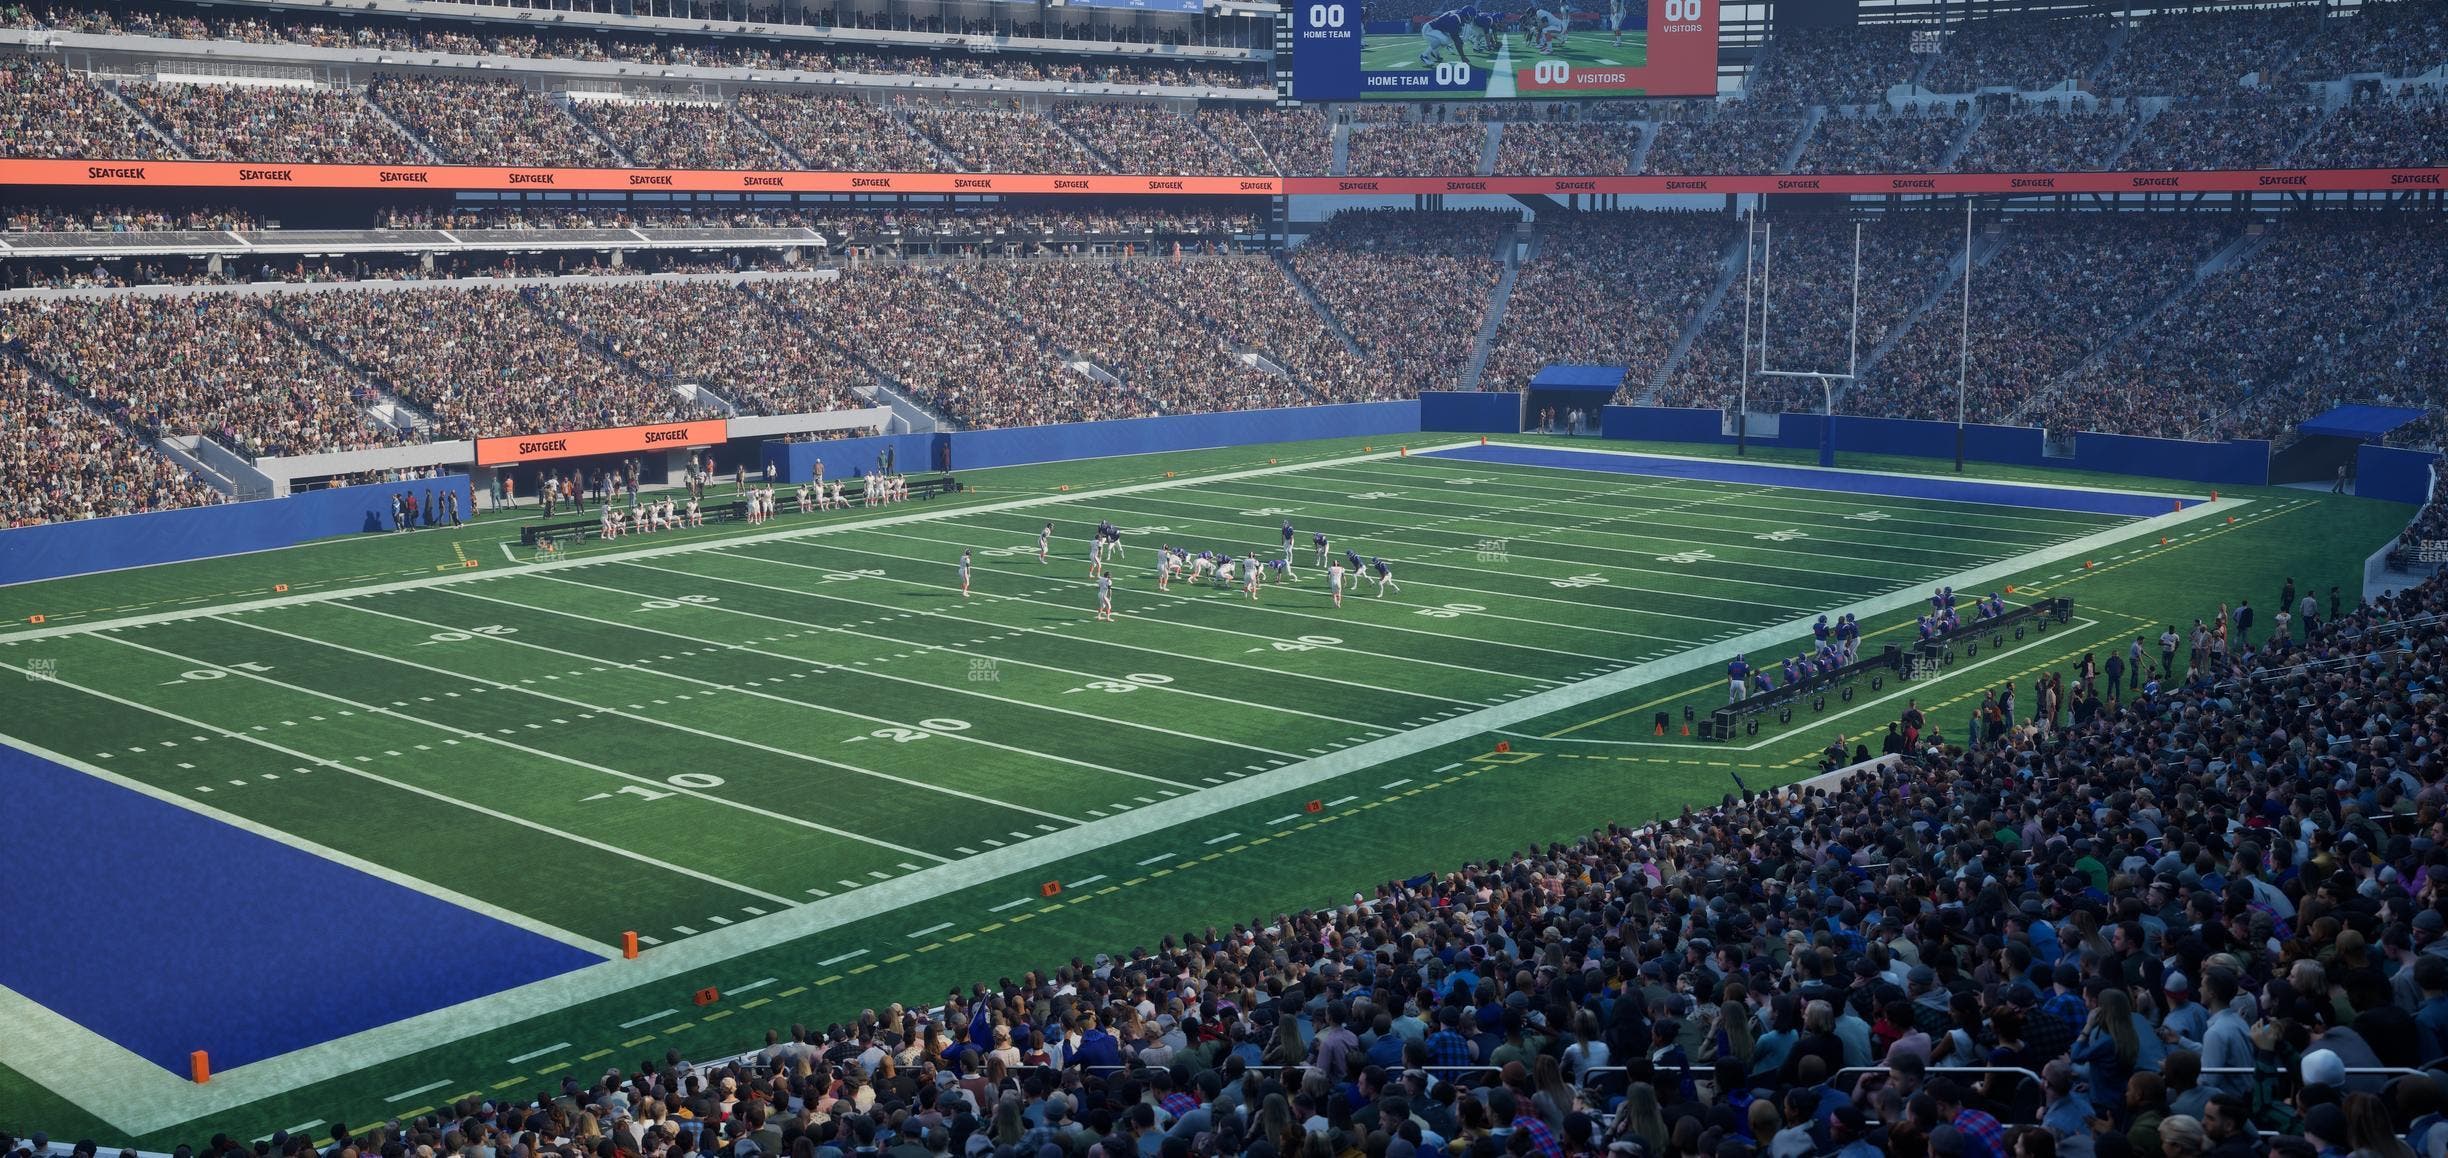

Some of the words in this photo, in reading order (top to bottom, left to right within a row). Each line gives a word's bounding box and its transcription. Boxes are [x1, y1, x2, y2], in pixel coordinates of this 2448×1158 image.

[1310, 4, 1345, 28] 00
[1665, 0, 1701, 21] 00
[1663, 24, 1702, 33] VISITORS
[1303, 31, 1327, 39] HOME
[1328, 31, 1351, 39] TEAM
[1367, 76, 1398, 86] HOME
[1400, 76, 1429, 86] TEAM
[1435, 62, 1471, 86] 00
[1535, 60, 1569, 84] 00
[1576, 74, 1626, 83] VISITORS
[88, 166, 146, 180] SEATGEEK
[239, 169, 292, 182] SEATGEEK
[379, 171, 428, 183] SEATGEEK
[508, 173, 554, 184] SEATGEEK
[629, 174, 673, 186] SEATGEEK
[743, 176, 784, 187] SEATGEEK
[851, 178, 891, 188] SEATGEEK
[954, 179, 992, 189] SEATGEEK
[1054, 180, 1089, 189] SEATGEEK
[1148, 181, 1183, 190] SEATGEEK
[1555, 181, 1595, 190] SEATGEEK
[1666, 181, 1707, 190] SEATGEEK
[1778, 180, 1820, 190] SEATGEEK
[1892, 179, 1935, 189] SEATGEEK
[2011, 178, 2055, 189] SEATGEEK
[2132, 176, 2179, 188] SEATGEEK
[2259, 175, 2307, 187] SEATGEEK
[2391, 174, 2440, 186] SEATGEEK
[1240, 182, 1273, 191] SEATGEEK
[1339, 182, 1379, 191] SEATGEEK
[1446, 182, 1487, 191] SEATGEEK
[645, 427, 688, 443] SEATGEEK
[519, 438, 567, 455] SEATGEEK
[641, 595, 720, 609] 30
[1412, 603, 1487, 618] 50
[429, 624, 518, 641] 20
[1271, 635, 1344, 652] 40
[180, 662, 275, 680] 10
[1086, 673, 1174, 693] 30
[871, 718, 972, 743] 20
[616, 773, 726, 801] 10
